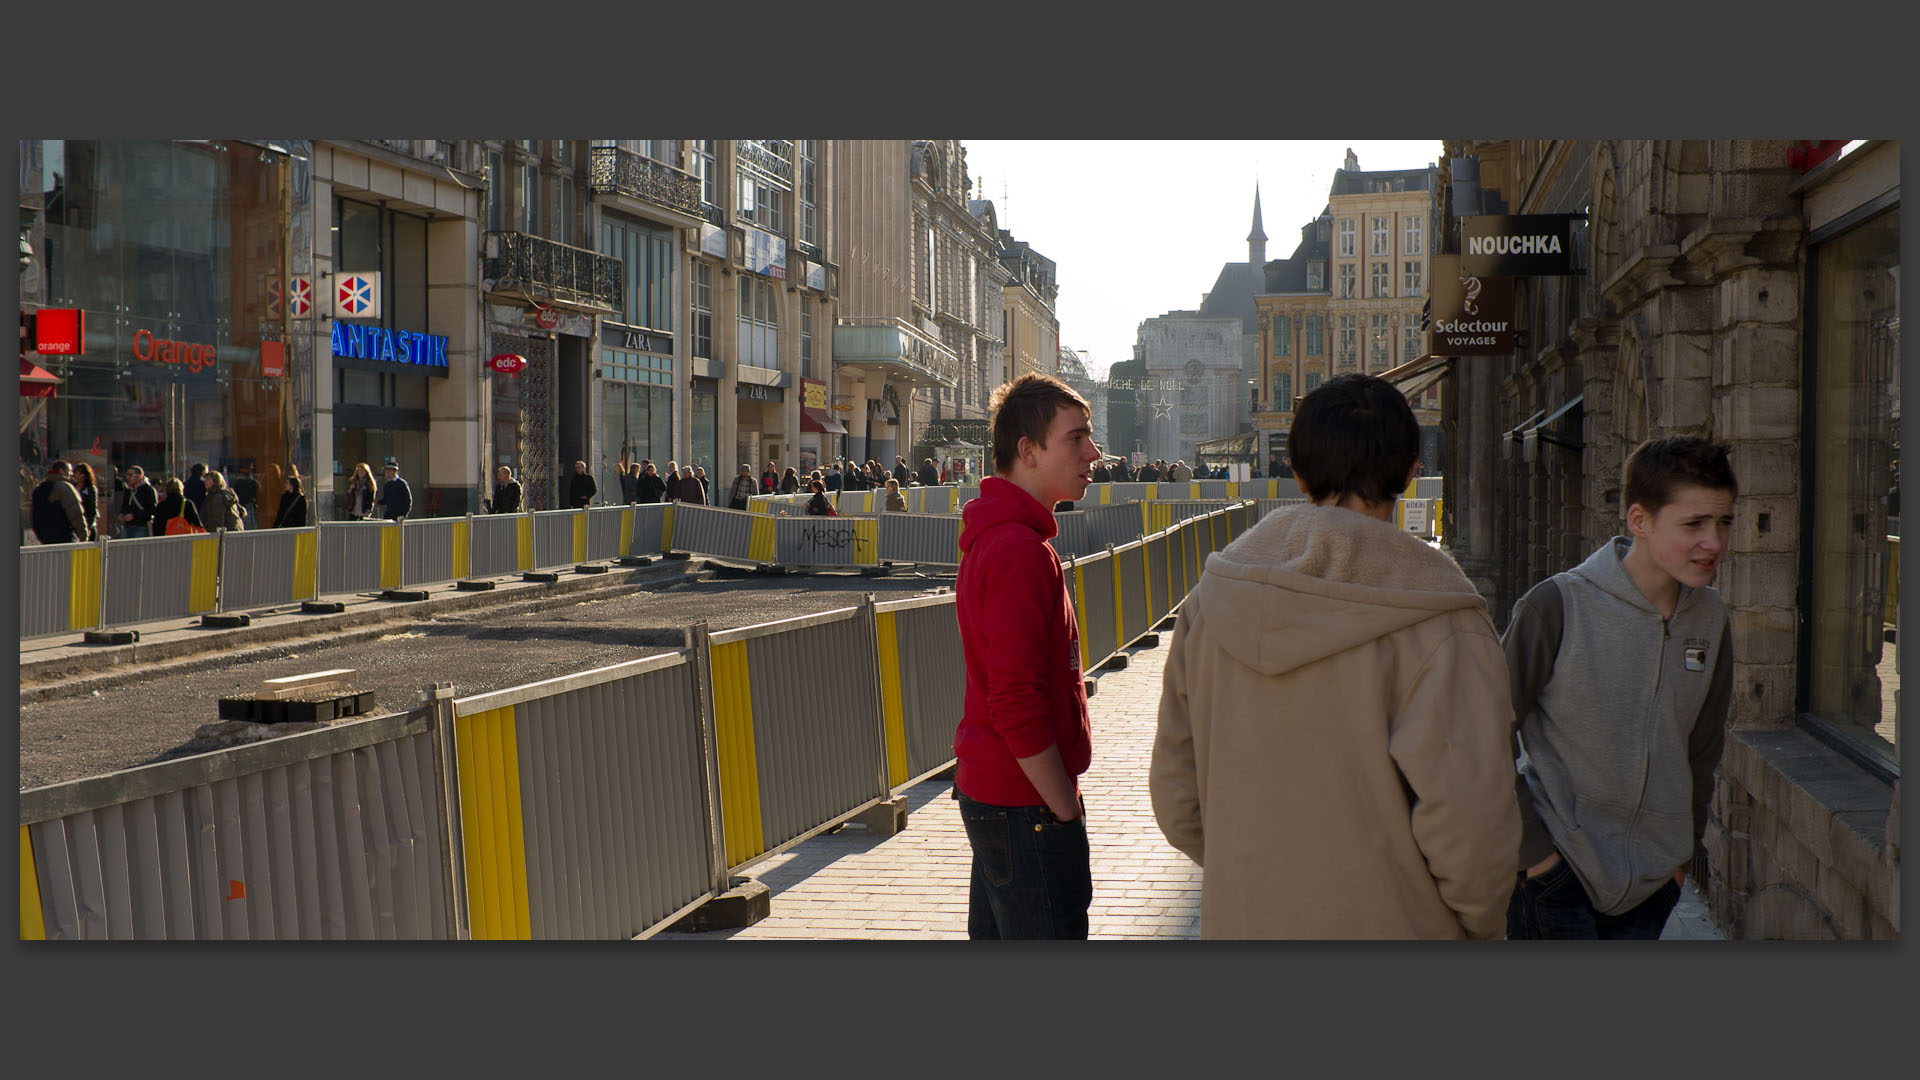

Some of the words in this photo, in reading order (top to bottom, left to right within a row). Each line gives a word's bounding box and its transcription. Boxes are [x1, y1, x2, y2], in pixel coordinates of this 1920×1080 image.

[1469, 235, 1562, 255] NOUCHKA
[1435, 318, 1508, 333] Selectour
[38, 342, 70, 353] orange
[624, 331, 651, 351] ZARA
[1447, 337, 1496, 346] VOYAGES
[133, 329, 216, 373] Orange
[496, 356, 517, 369] edc
[750, 386, 768, 400] ZARA
